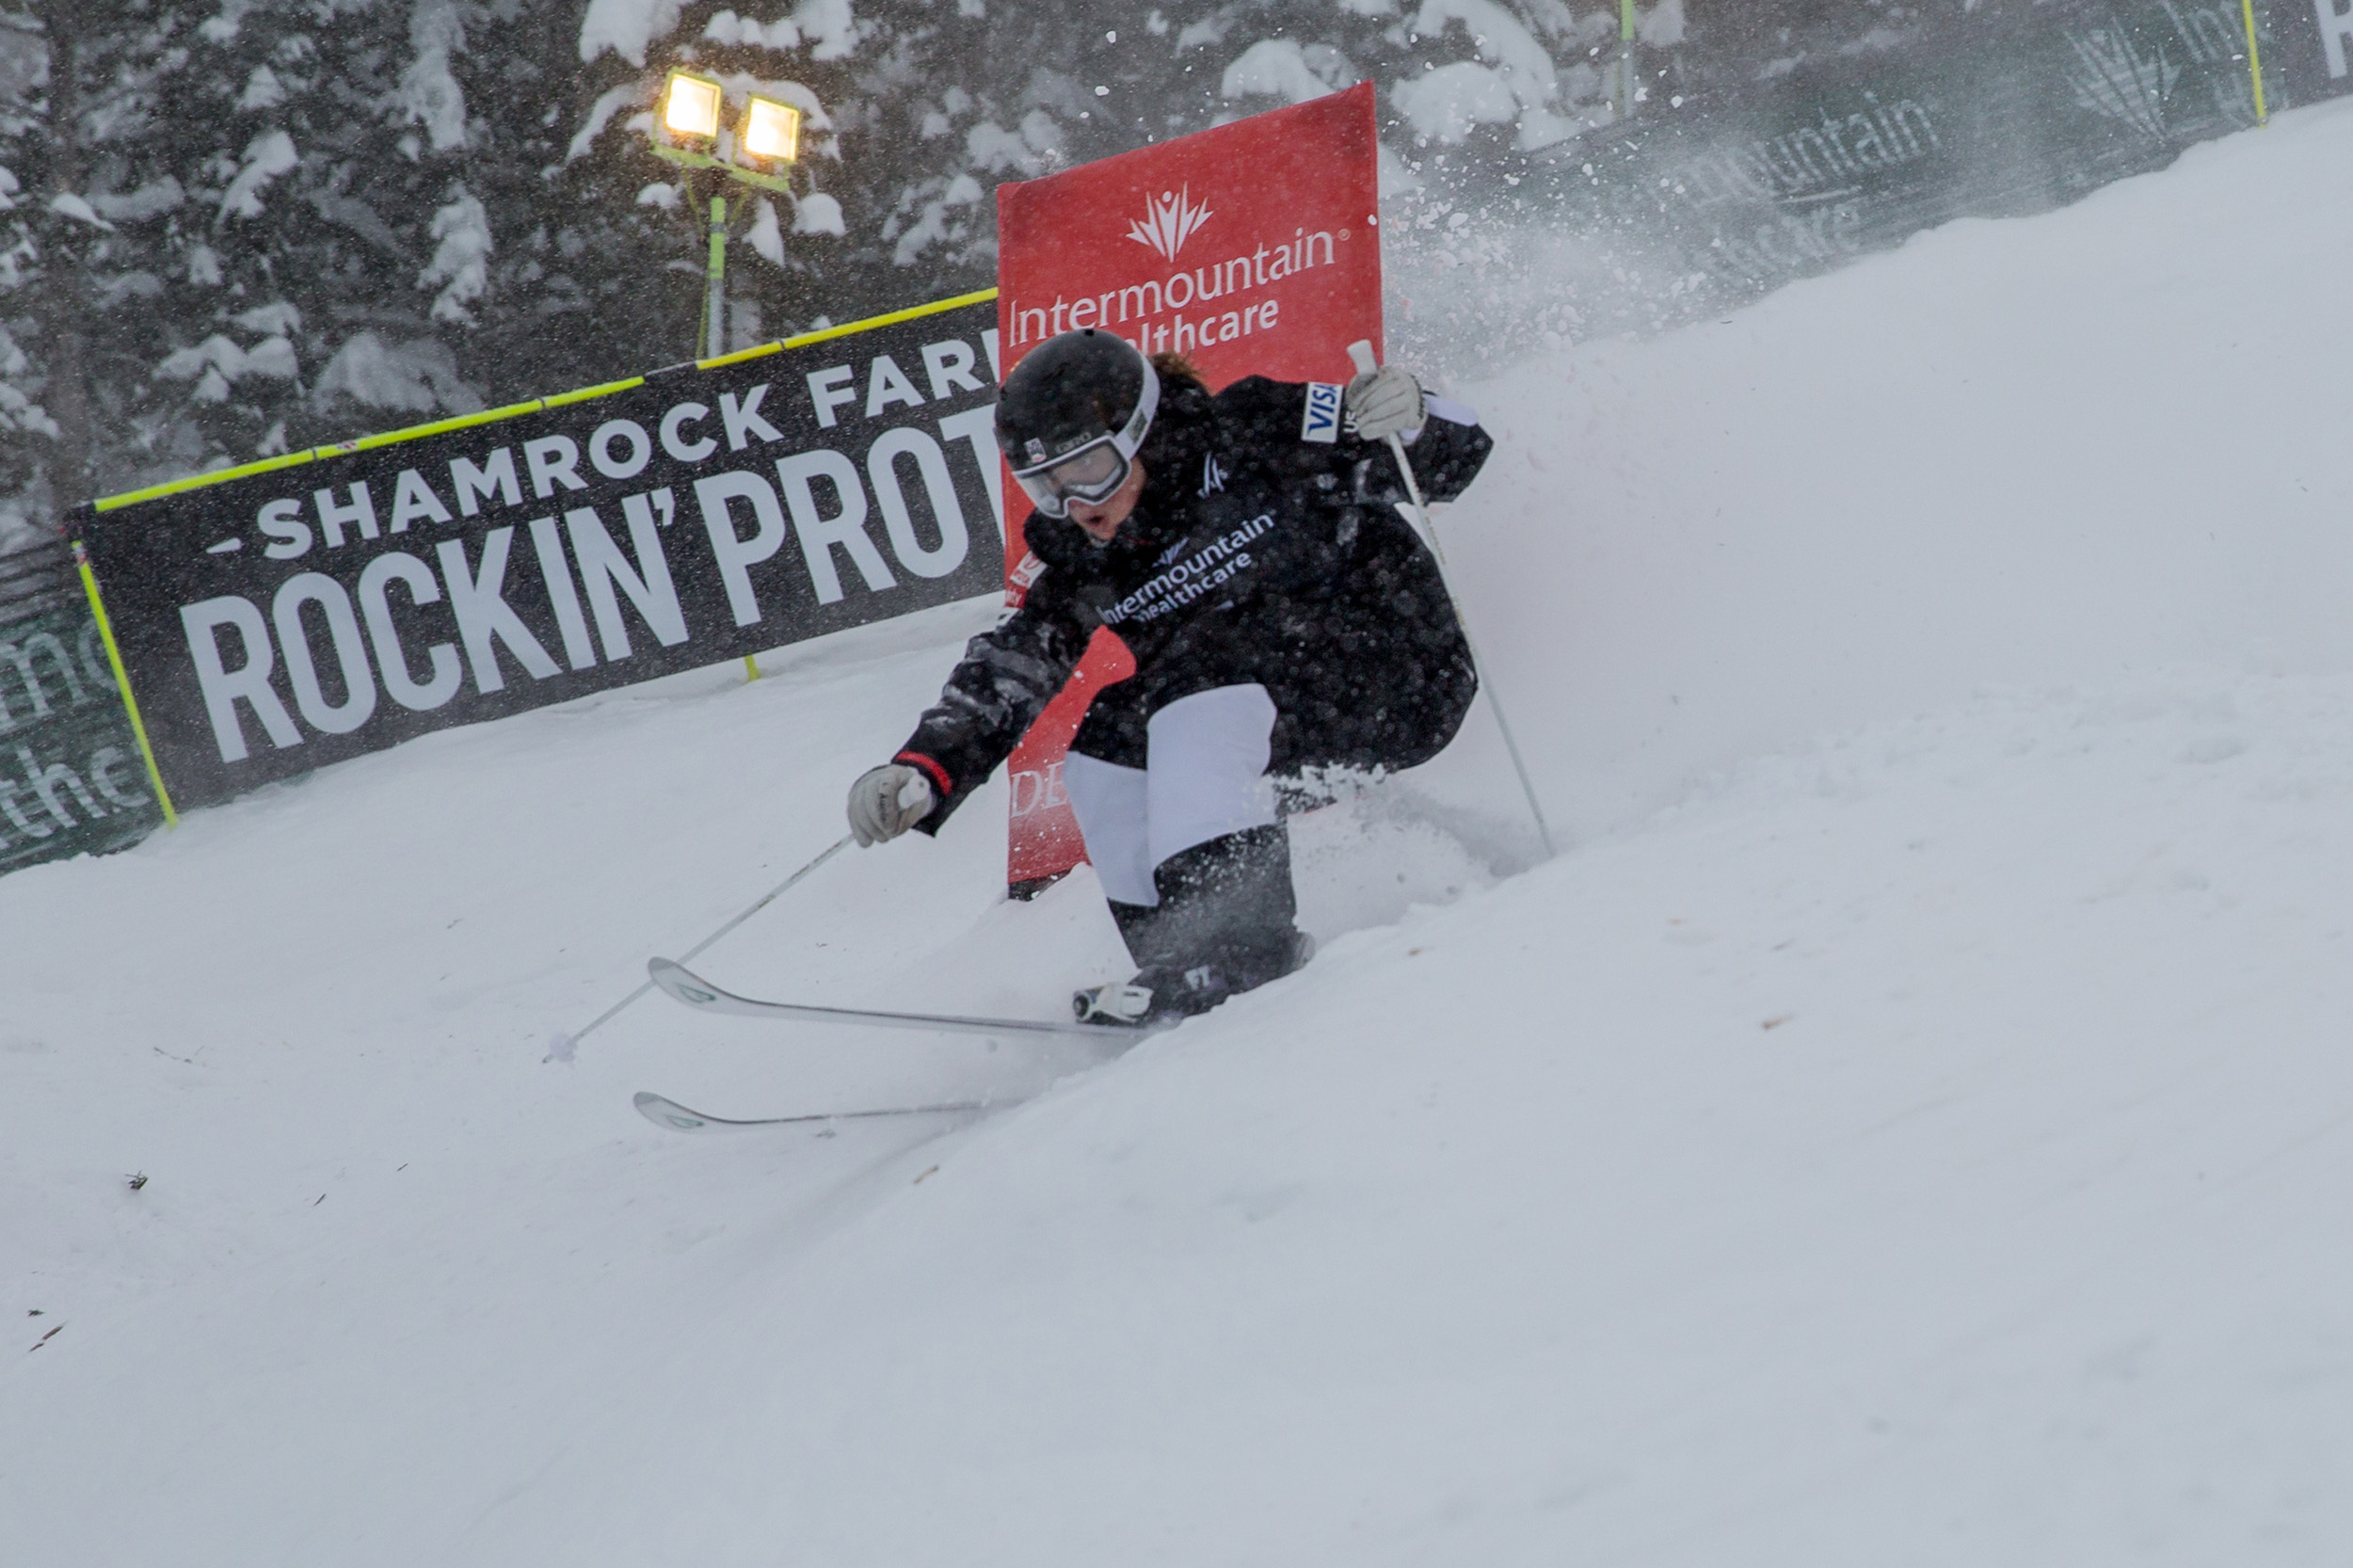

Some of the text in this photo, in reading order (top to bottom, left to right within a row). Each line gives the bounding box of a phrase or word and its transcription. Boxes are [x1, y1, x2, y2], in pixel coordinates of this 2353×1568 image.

[1009, 227, 1335, 348] Intermountain
[1125, 299, 1279, 356] lthcare
[257, 328, 1000, 559] SHAMROCK FAR
[1306, 384, 1337, 435] VISA
[179, 488, 689, 764] ROCKIN'
[1096, 514, 1274, 625] Intermountain
